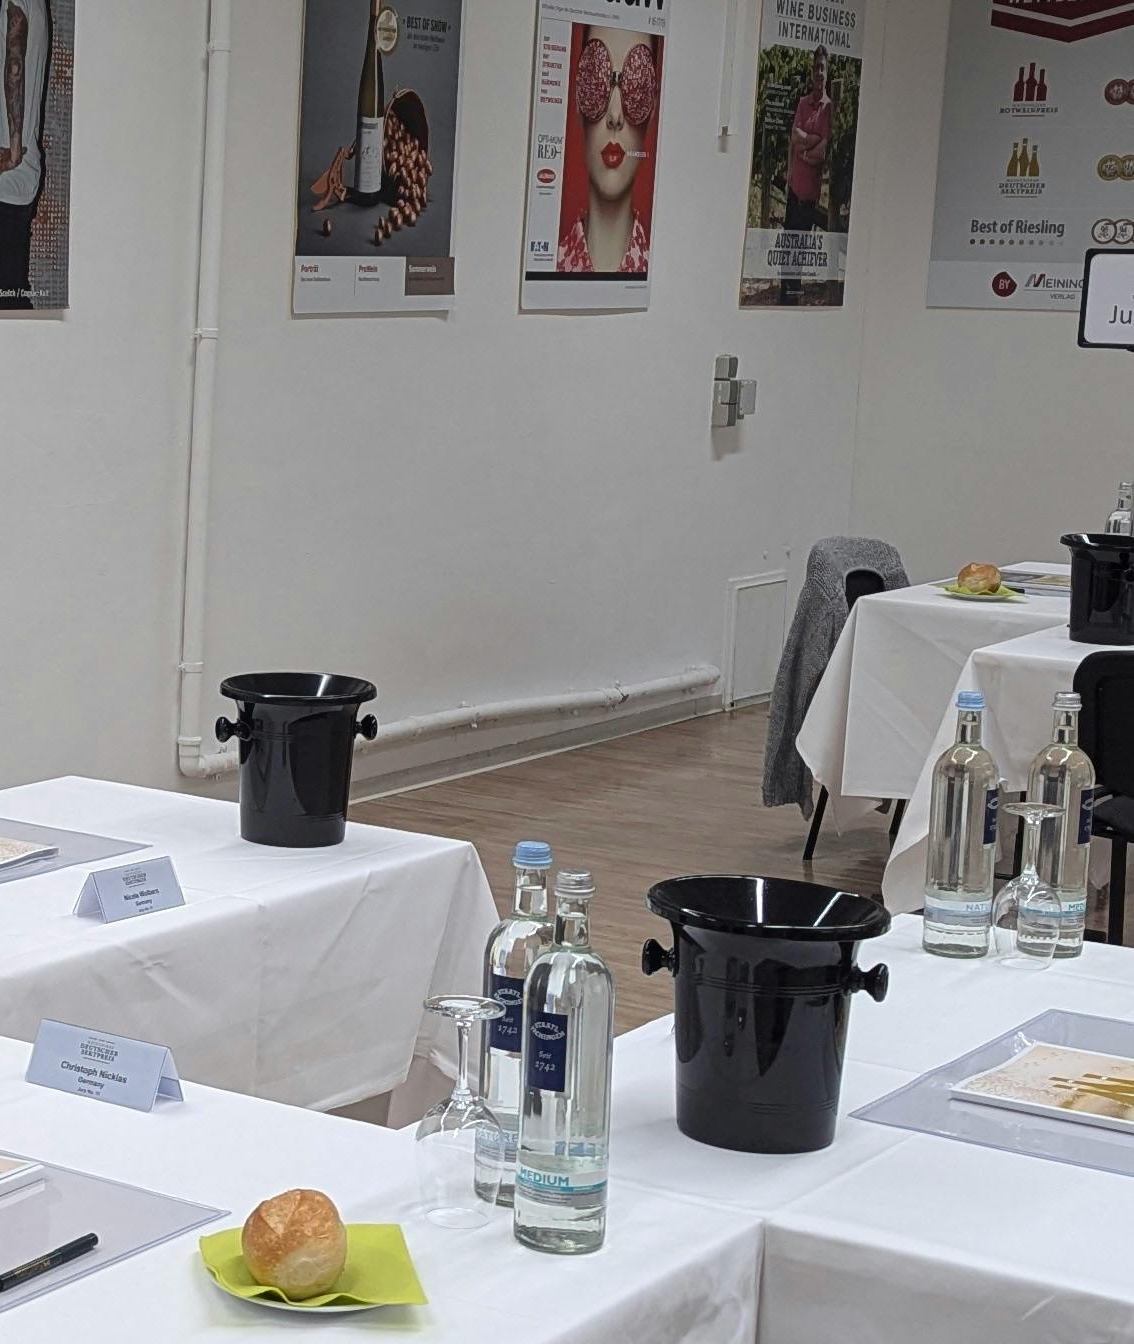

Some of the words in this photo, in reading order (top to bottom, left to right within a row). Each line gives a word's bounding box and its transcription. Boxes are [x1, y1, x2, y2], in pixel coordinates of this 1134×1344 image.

[807, 3, 856, 28] BUSINESS
[778, 20, 851, 48] INTERNATIONAL
[970, 219, 997, 233] Best
[1000, 220, 1014, 233] of
[1016, 220, 1065, 237] Riesling
[998, 278, 1010, 289] BY
[1025, 273, 1084, 289] MEININ
[1109, 305, 1134, 324] Ju
[497, 1024, 518, 1035] 1742
[60, 1060, 98, 1077] Christoph
[534, 1060, 556, 1072] 1742
[77, 1076, 106, 1090] Germany
[520, 1166, 570, 1187] MEDIUM
